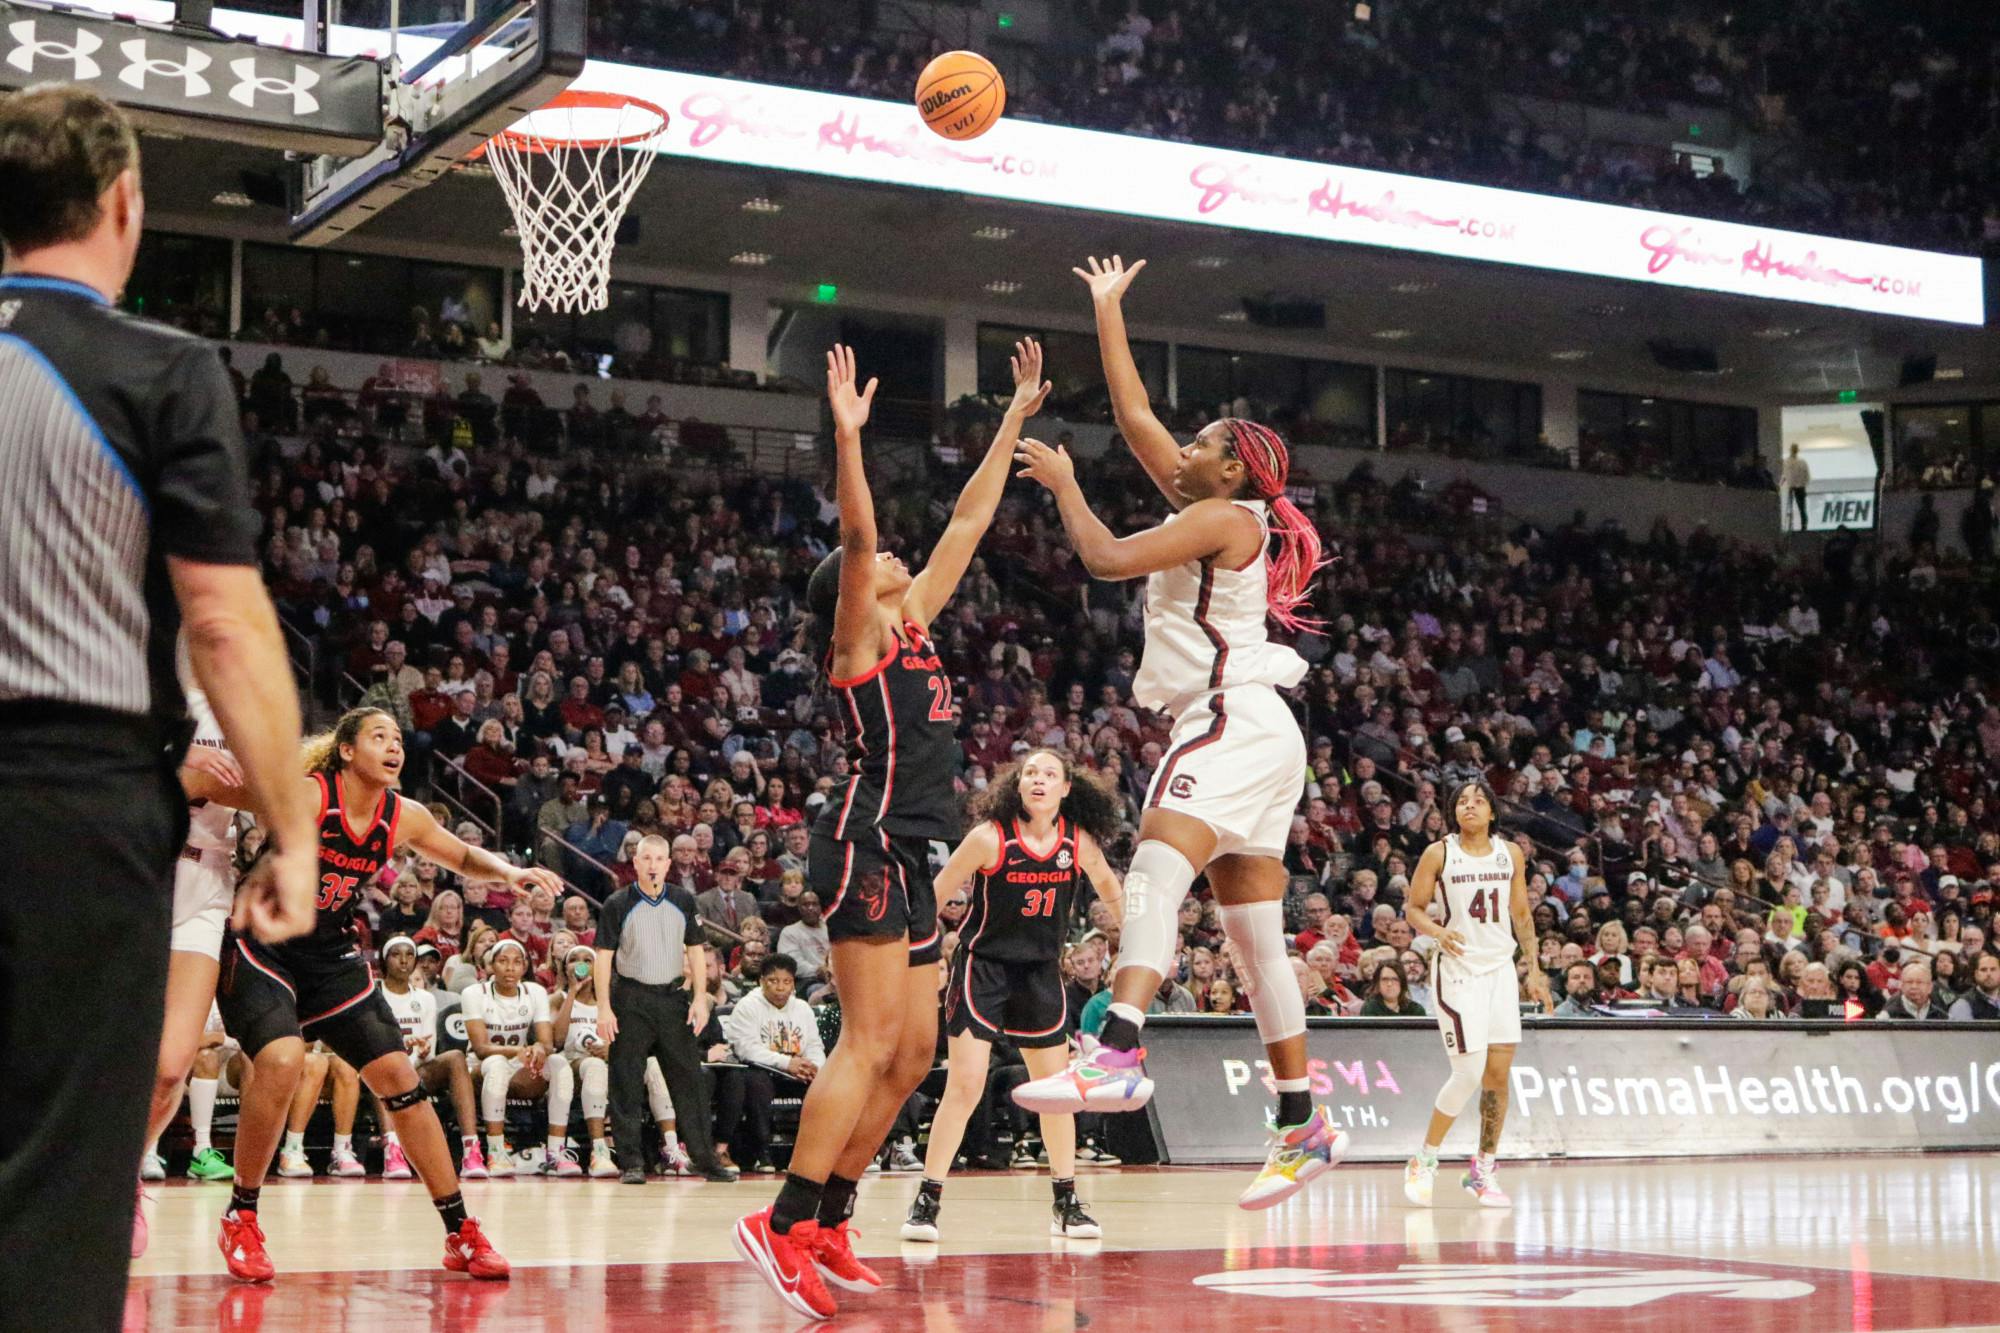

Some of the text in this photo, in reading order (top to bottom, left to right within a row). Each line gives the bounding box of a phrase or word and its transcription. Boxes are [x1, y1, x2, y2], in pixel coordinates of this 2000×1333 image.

[921, 84, 972, 115] Wilson
[1821, 500, 1871, 522] MEN
[315, 872, 360, 912] 35
[1006, 871, 1072, 884] GEORGIA
[1451, 874, 1476, 884] SOUTH
[1021, 888, 1057, 917] 31
[1468, 887, 1500, 924] 41
